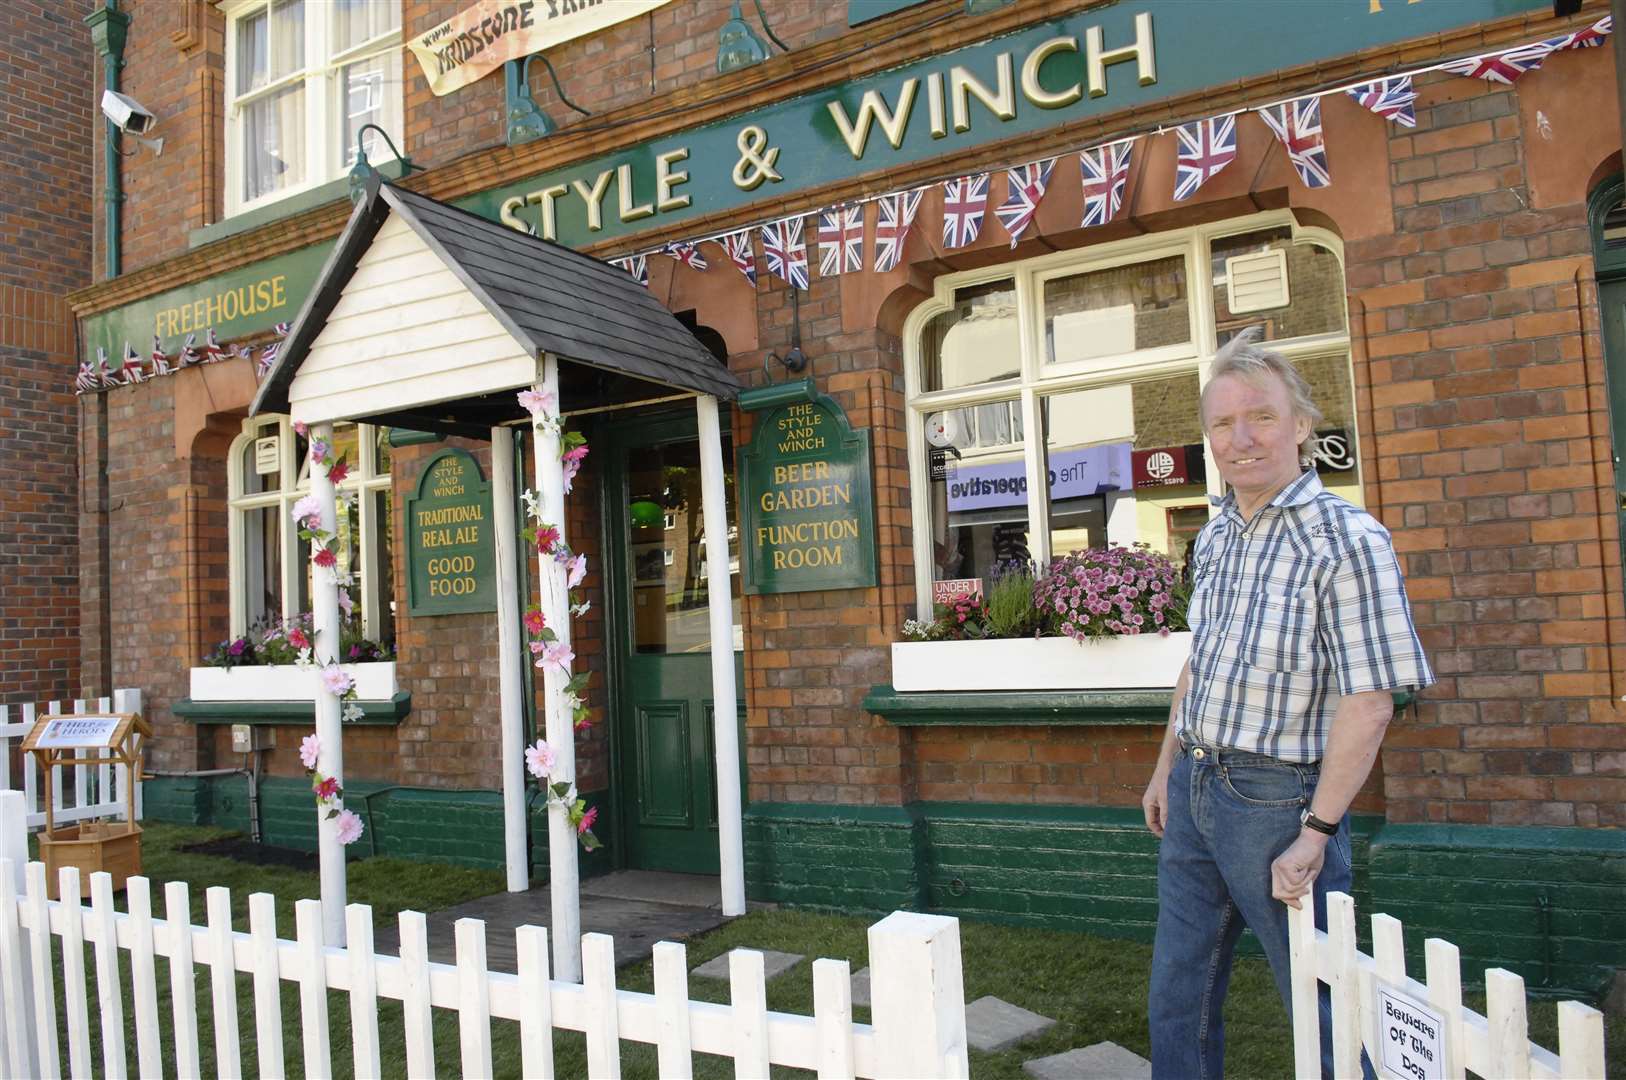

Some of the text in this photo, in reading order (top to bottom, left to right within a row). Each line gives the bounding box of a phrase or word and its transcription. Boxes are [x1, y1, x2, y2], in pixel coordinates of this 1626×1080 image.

[500, 12, 1157, 241] STYLE & WINCH
[155, 275, 287, 337] FREEHOUSE
[788, 403, 814, 417] THE
[778, 414, 822, 430] STYLE
[786, 427, 814, 441] AND
[778, 437, 825, 453] WINCH
[433, 466, 464, 479] STYLE
[440, 457, 458, 467] THE
[774, 460, 830, 485] BEER
[433, 485, 464, 497] WINCH
[439, 476, 458, 486] AND
[761, 483, 851, 512] GARDEN
[417, 504, 483, 527] TRADITIONAL
[422, 525, 479, 548] REAL ALE
[757, 518, 859, 547] FUNCTION
[428, 555, 475, 576] GOOD
[773, 545, 843, 570] ROOM
[430, 577, 476, 597] FOOD
[935, 581, 970, 593] UNDER
[1385, 999, 1435, 1040] Beware
[1390, 1026, 1433, 1062] Of The
